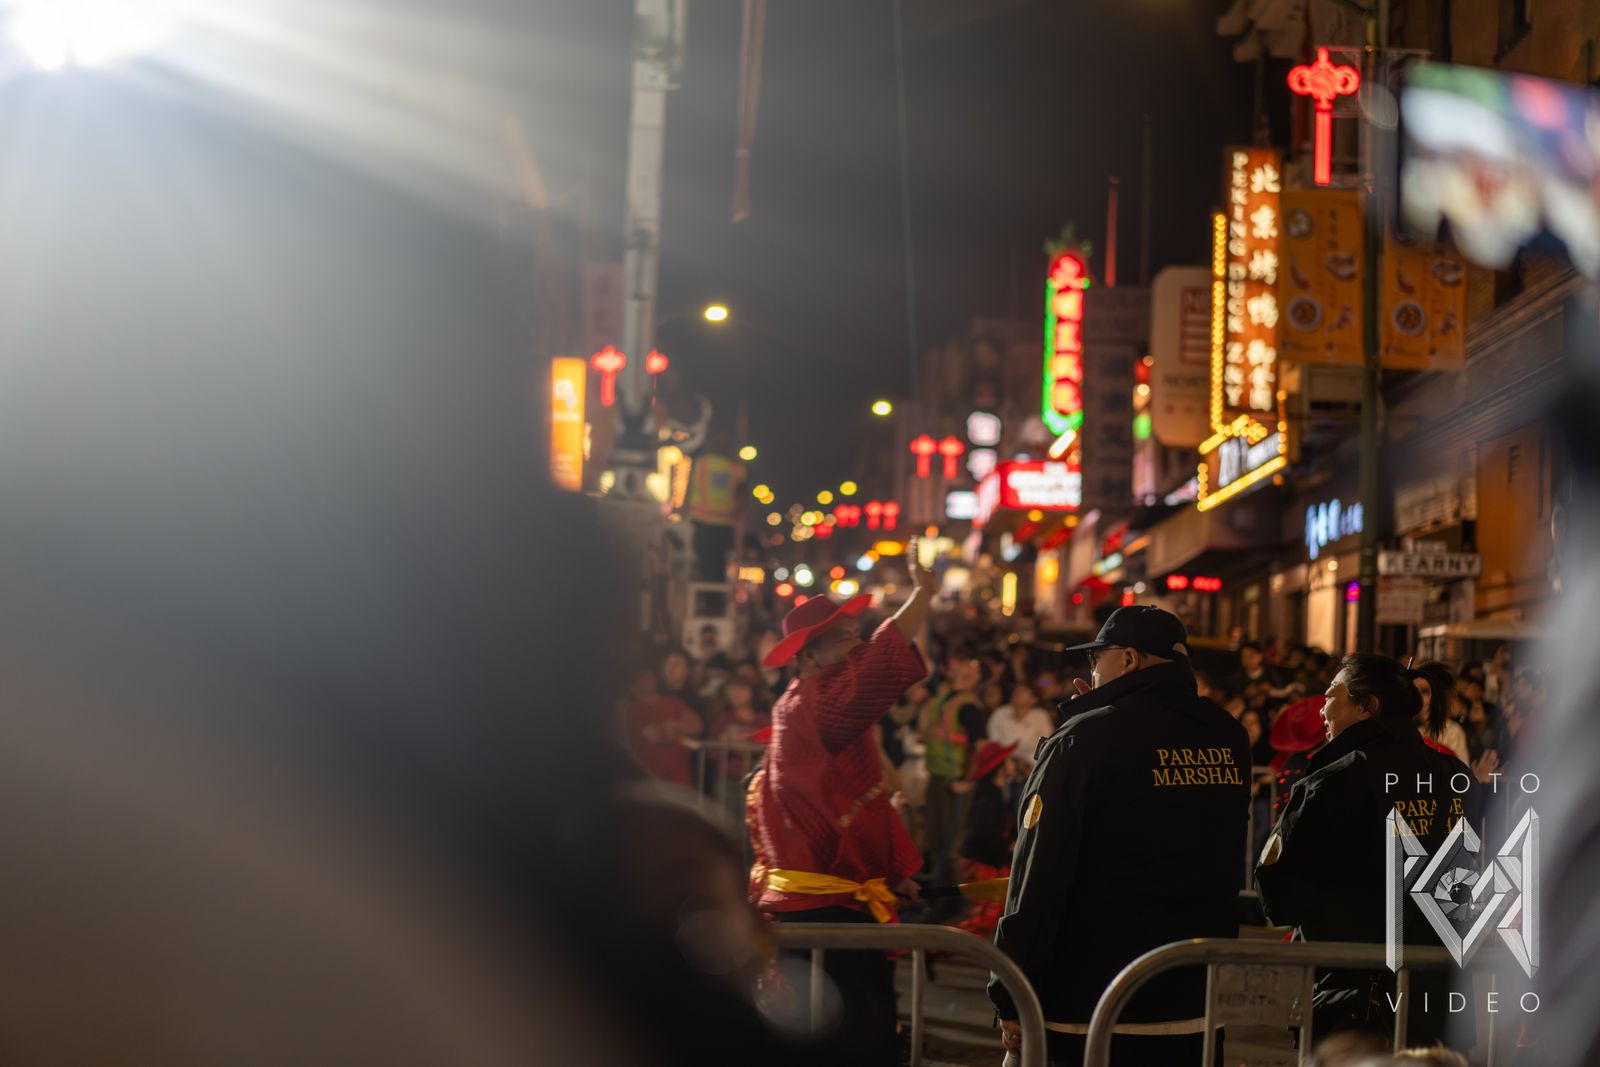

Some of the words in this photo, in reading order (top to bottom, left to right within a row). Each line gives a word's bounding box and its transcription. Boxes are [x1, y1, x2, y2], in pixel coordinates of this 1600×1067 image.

[1228, 151, 1248, 257] PEKING
[1226, 262, 1247, 333] DUCK
[1386, 556, 1478, 573] KEARNY
[1156, 748, 1235, 766] PARADE
[1152, 767, 1243, 786] MARSHAL
[1395, 798, 1464, 818] PARAE
